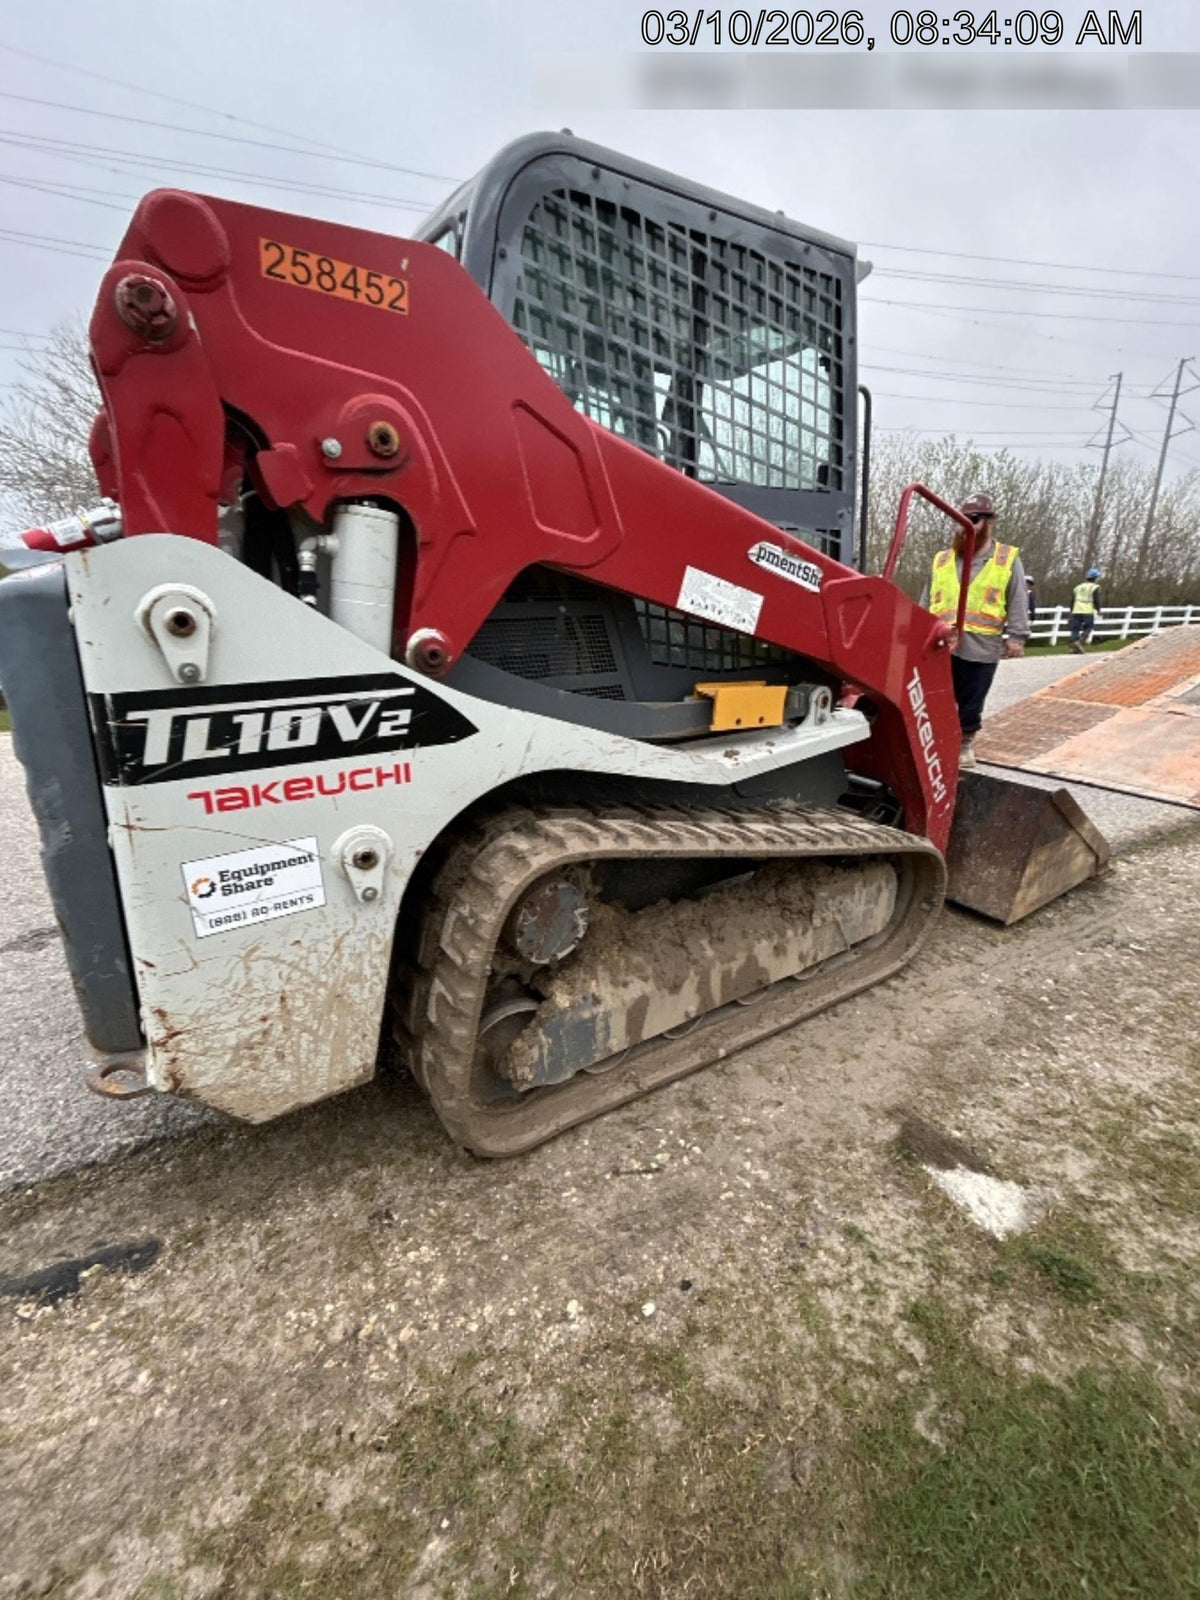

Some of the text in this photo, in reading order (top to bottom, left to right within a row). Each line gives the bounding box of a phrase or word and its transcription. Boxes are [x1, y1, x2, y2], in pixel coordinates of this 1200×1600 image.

[264, 242, 406, 312] 258452
[126, 688, 416, 766] TL10V2
[907, 666, 947, 803] TAKEUCHI
[187, 762, 412, 814] TAKEUCHI
[218, 853, 315, 882] Equipment
[220, 877, 274, 897] Share
